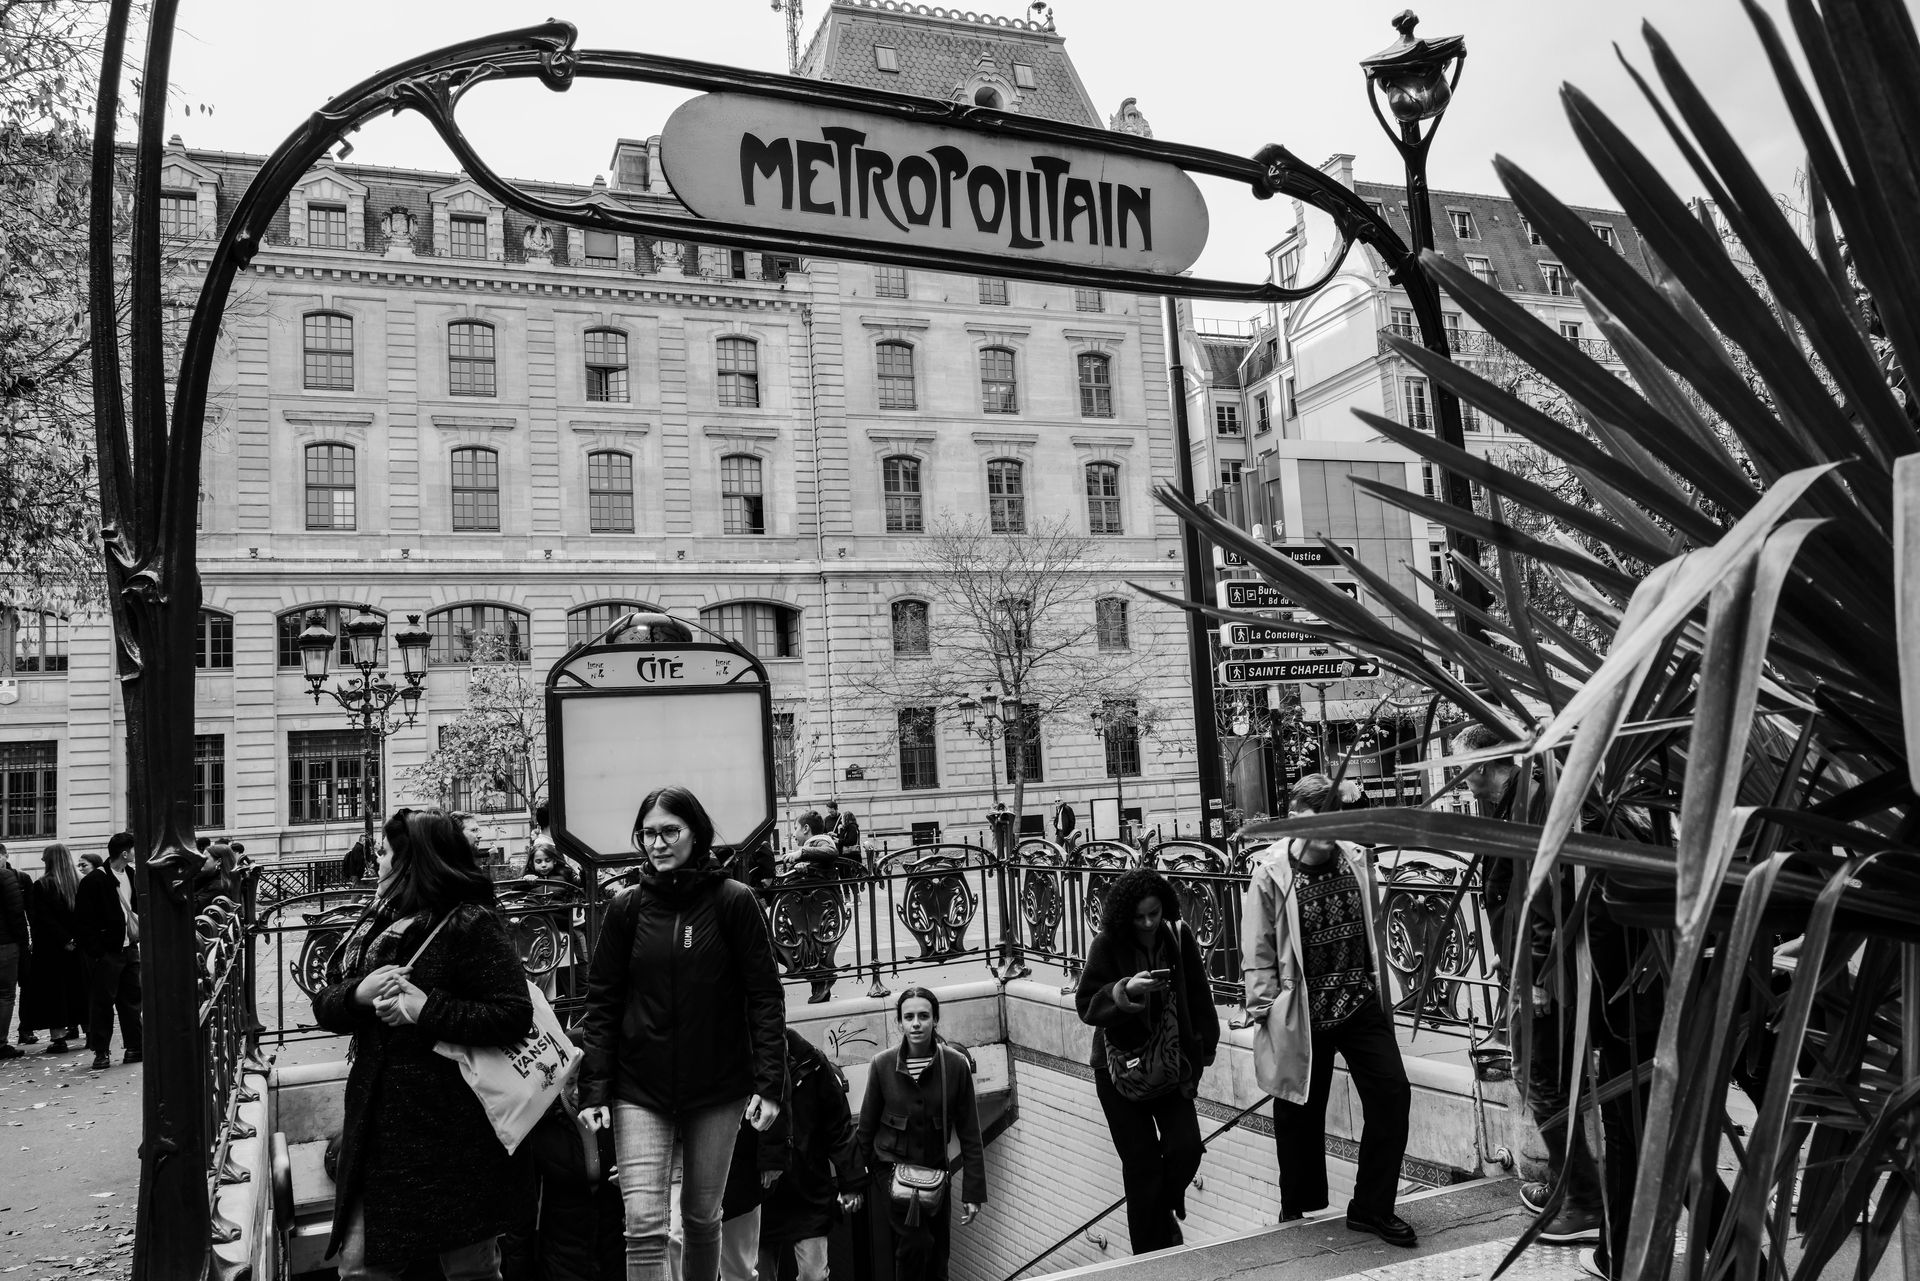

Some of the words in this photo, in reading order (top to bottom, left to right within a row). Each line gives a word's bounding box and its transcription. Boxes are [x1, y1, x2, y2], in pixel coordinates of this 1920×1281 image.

[739, 126, 1154, 252] METROPOLITAIN
[1289, 551, 1322, 561] Justice
[1258, 585, 1281, 595] Bure
[1268, 597, 1278, 605] Bd
[1280, 597, 1289, 605] du
[1250, 629, 1261, 639] La
[1264, 629, 1316, 641] Concierge
[636, 653, 684, 683] CITÉ
[1248, 665, 1287, 677] SAINTE
[683, 925, 693, 949] COLMAR
